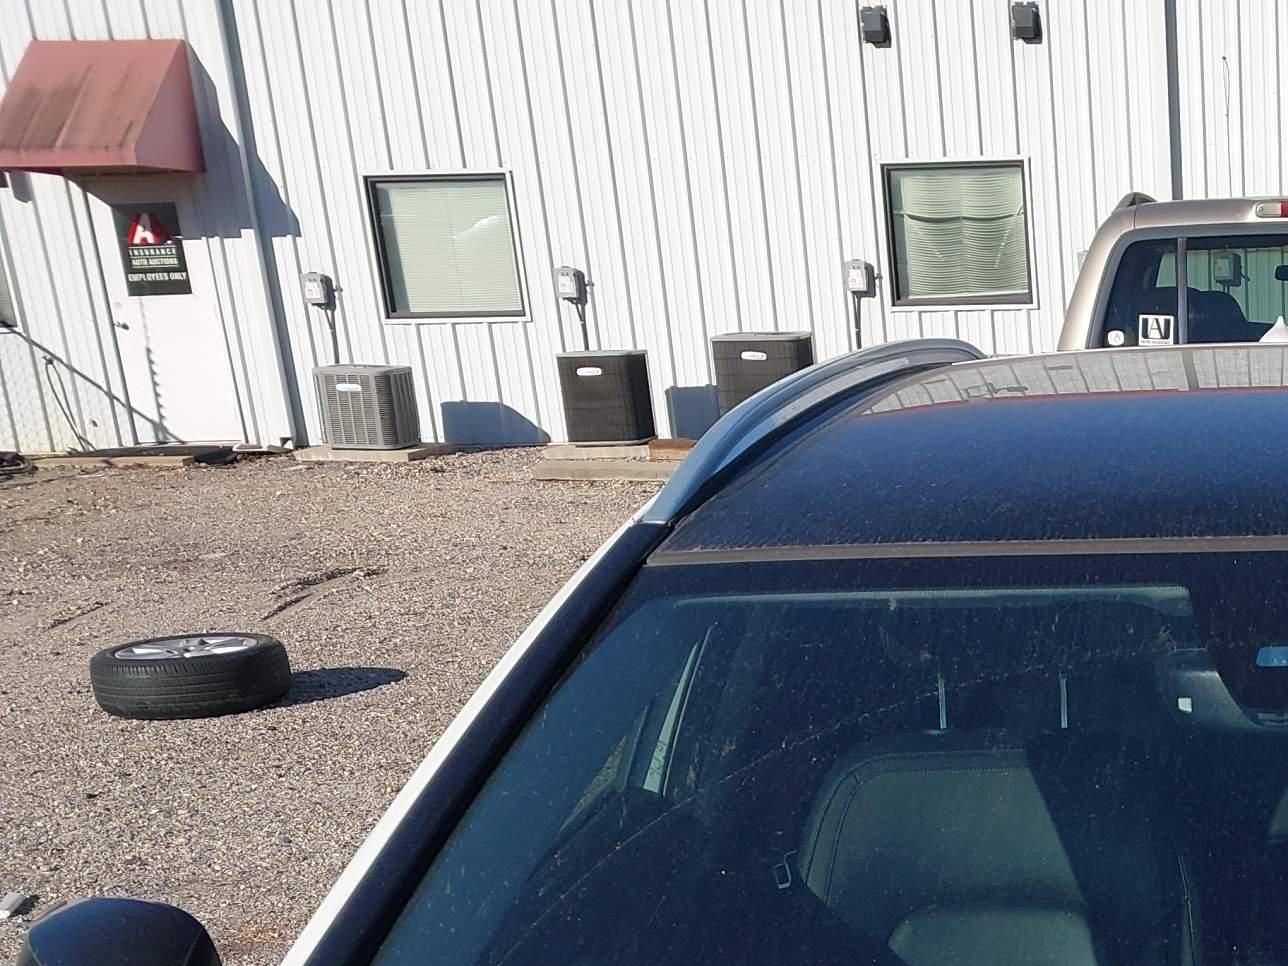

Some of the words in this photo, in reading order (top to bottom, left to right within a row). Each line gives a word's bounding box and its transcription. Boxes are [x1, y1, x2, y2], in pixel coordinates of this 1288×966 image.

[128, 248, 176, 256] INSURANCE
[128, 273, 168, 281] EMPLOYEES
[170, 272, 186, 280] ONLY
